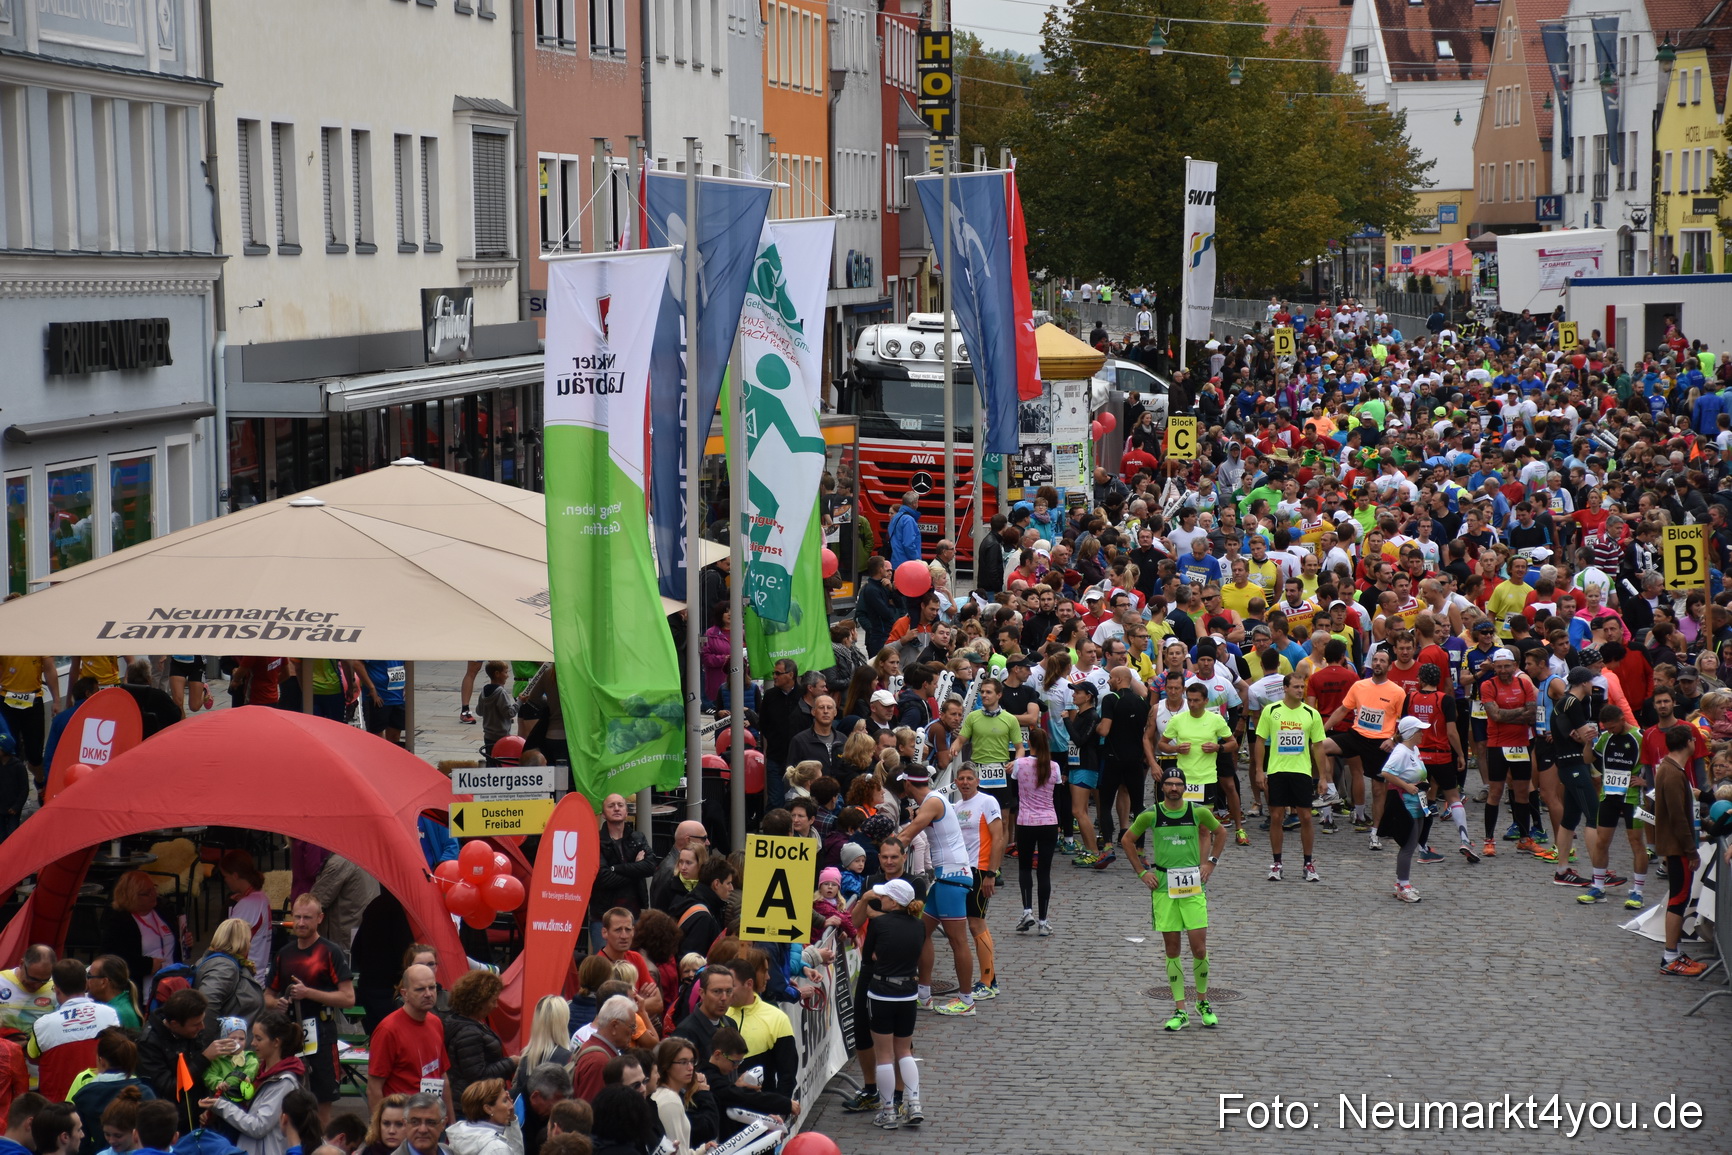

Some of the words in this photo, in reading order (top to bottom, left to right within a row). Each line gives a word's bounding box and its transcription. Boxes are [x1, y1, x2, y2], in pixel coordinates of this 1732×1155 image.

[1685, 126, 1701, 142] HOTEL
[1279, 336, 1289, 350] D
[1564, 330, 1574, 344] D
[60, 321, 119, 374] BRILLEN
[121, 318, 172, 369] WEBER
[1171, 418, 1193, 427] Block
[1174, 429, 1189, 450] C
[1668, 527, 1703, 540] Block
[1675, 545, 1698, 575] B
[147, 607, 339, 623] Neumarkter
[96, 621, 363, 642] Lammsbräu
[390, 672, 404, 682] 3039
[1414, 704, 1433, 714] BRIG
[1360, 711, 1381, 724] 2087
[1280, 736, 1302, 745] 2502
[82, 747, 108, 761] DKMS
[981, 769, 1004, 779] 3049
[1605, 775, 1627, 786] 3014
[459, 772, 543, 791] Klostergasse
[482, 807, 524, 818] Duschen
[485, 818, 521, 829] Freibad
[755, 839, 810, 861] Block
[553, 865, 573, 879] DKMS
[1175, 875, 1193, 886] 141
[756, 868, 797, 920] A
[532, 919, 572, 932] www.dkms.de
